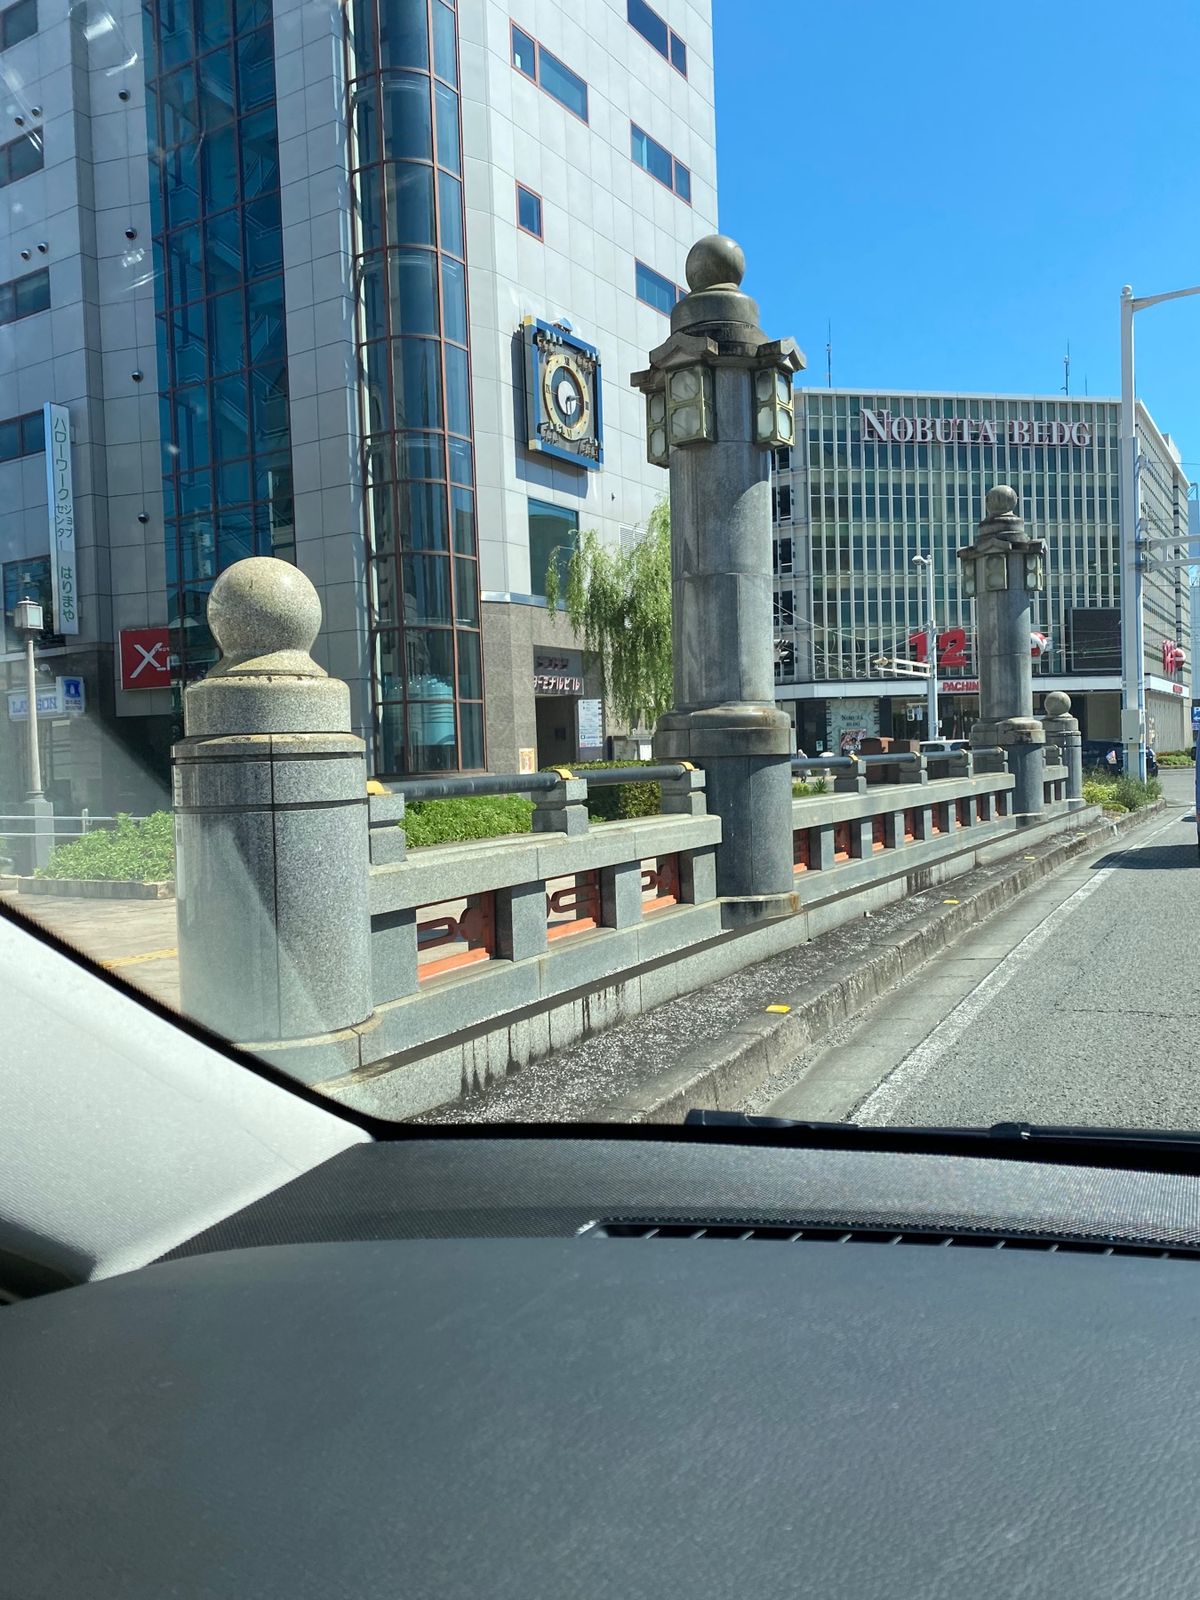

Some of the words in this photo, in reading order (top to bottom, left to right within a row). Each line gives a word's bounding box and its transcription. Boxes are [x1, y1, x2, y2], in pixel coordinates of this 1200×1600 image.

[861, 408, 998, 443] NOBUTA
[1008, 420, 1091, 446] BLDG
[54, 417, 69, 501] ハローワーク
[56, 504, 65, 552] センター
[60, 566, 75, 624] はりまや
